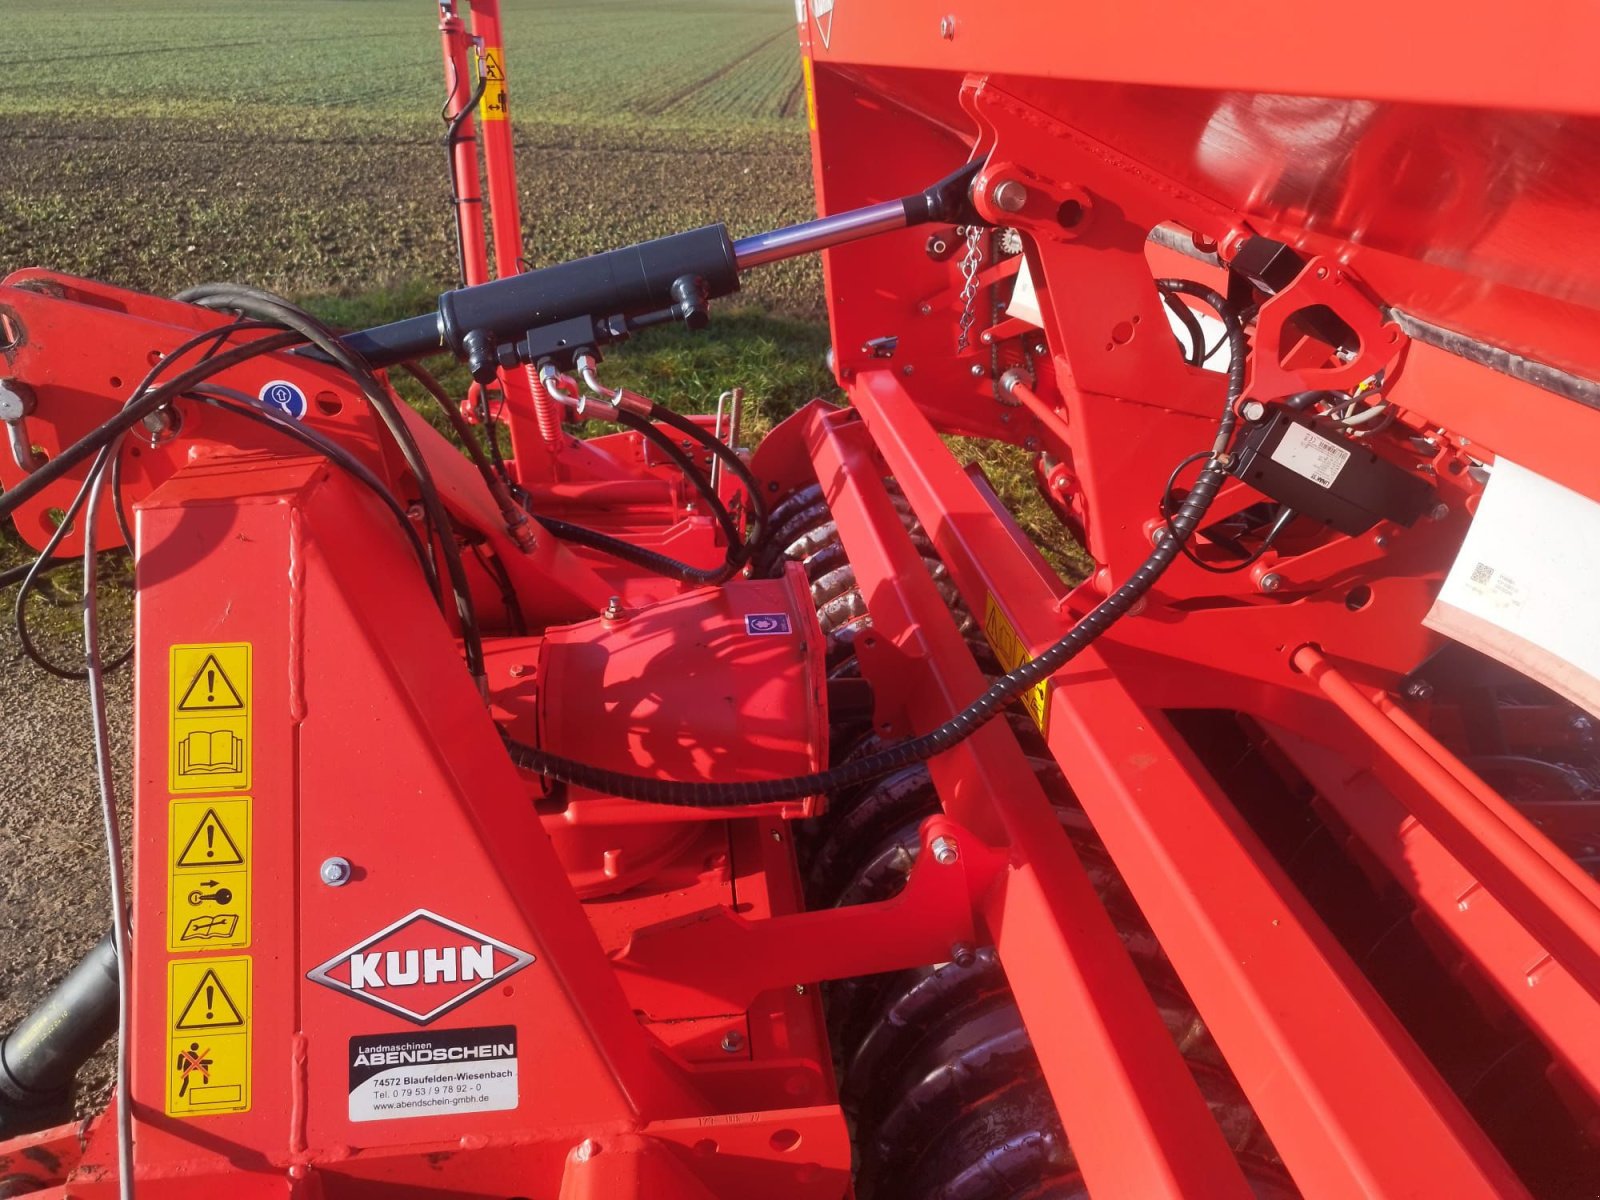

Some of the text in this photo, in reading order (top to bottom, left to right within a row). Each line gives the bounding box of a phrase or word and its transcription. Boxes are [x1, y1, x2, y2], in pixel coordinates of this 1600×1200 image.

[351, 945, 494, 989] KUHN
[353, 1043, 514, 1067] ABENDSCHEIN
[359, 1042, 431, 1054] Landmaschinen
[374, 1069, 513, 1088] 74572 Blaufelden-Wiesenbach
[373, 1091, 390, 1099] Tel.
[393, 1090, 399, 1098] 0
[402, 1089, 412, 1097] 79
[415, 1088, 426, 1096] 53
[434, 1086, 440, 1094] 9
[443, 1085, 454, 1093] 78
[456, 1084, 467, 1093] 92
[476, 1083, 482, 1091] 0
[373, 1094, 489, 1111] www.abendschein-gmbh.de
